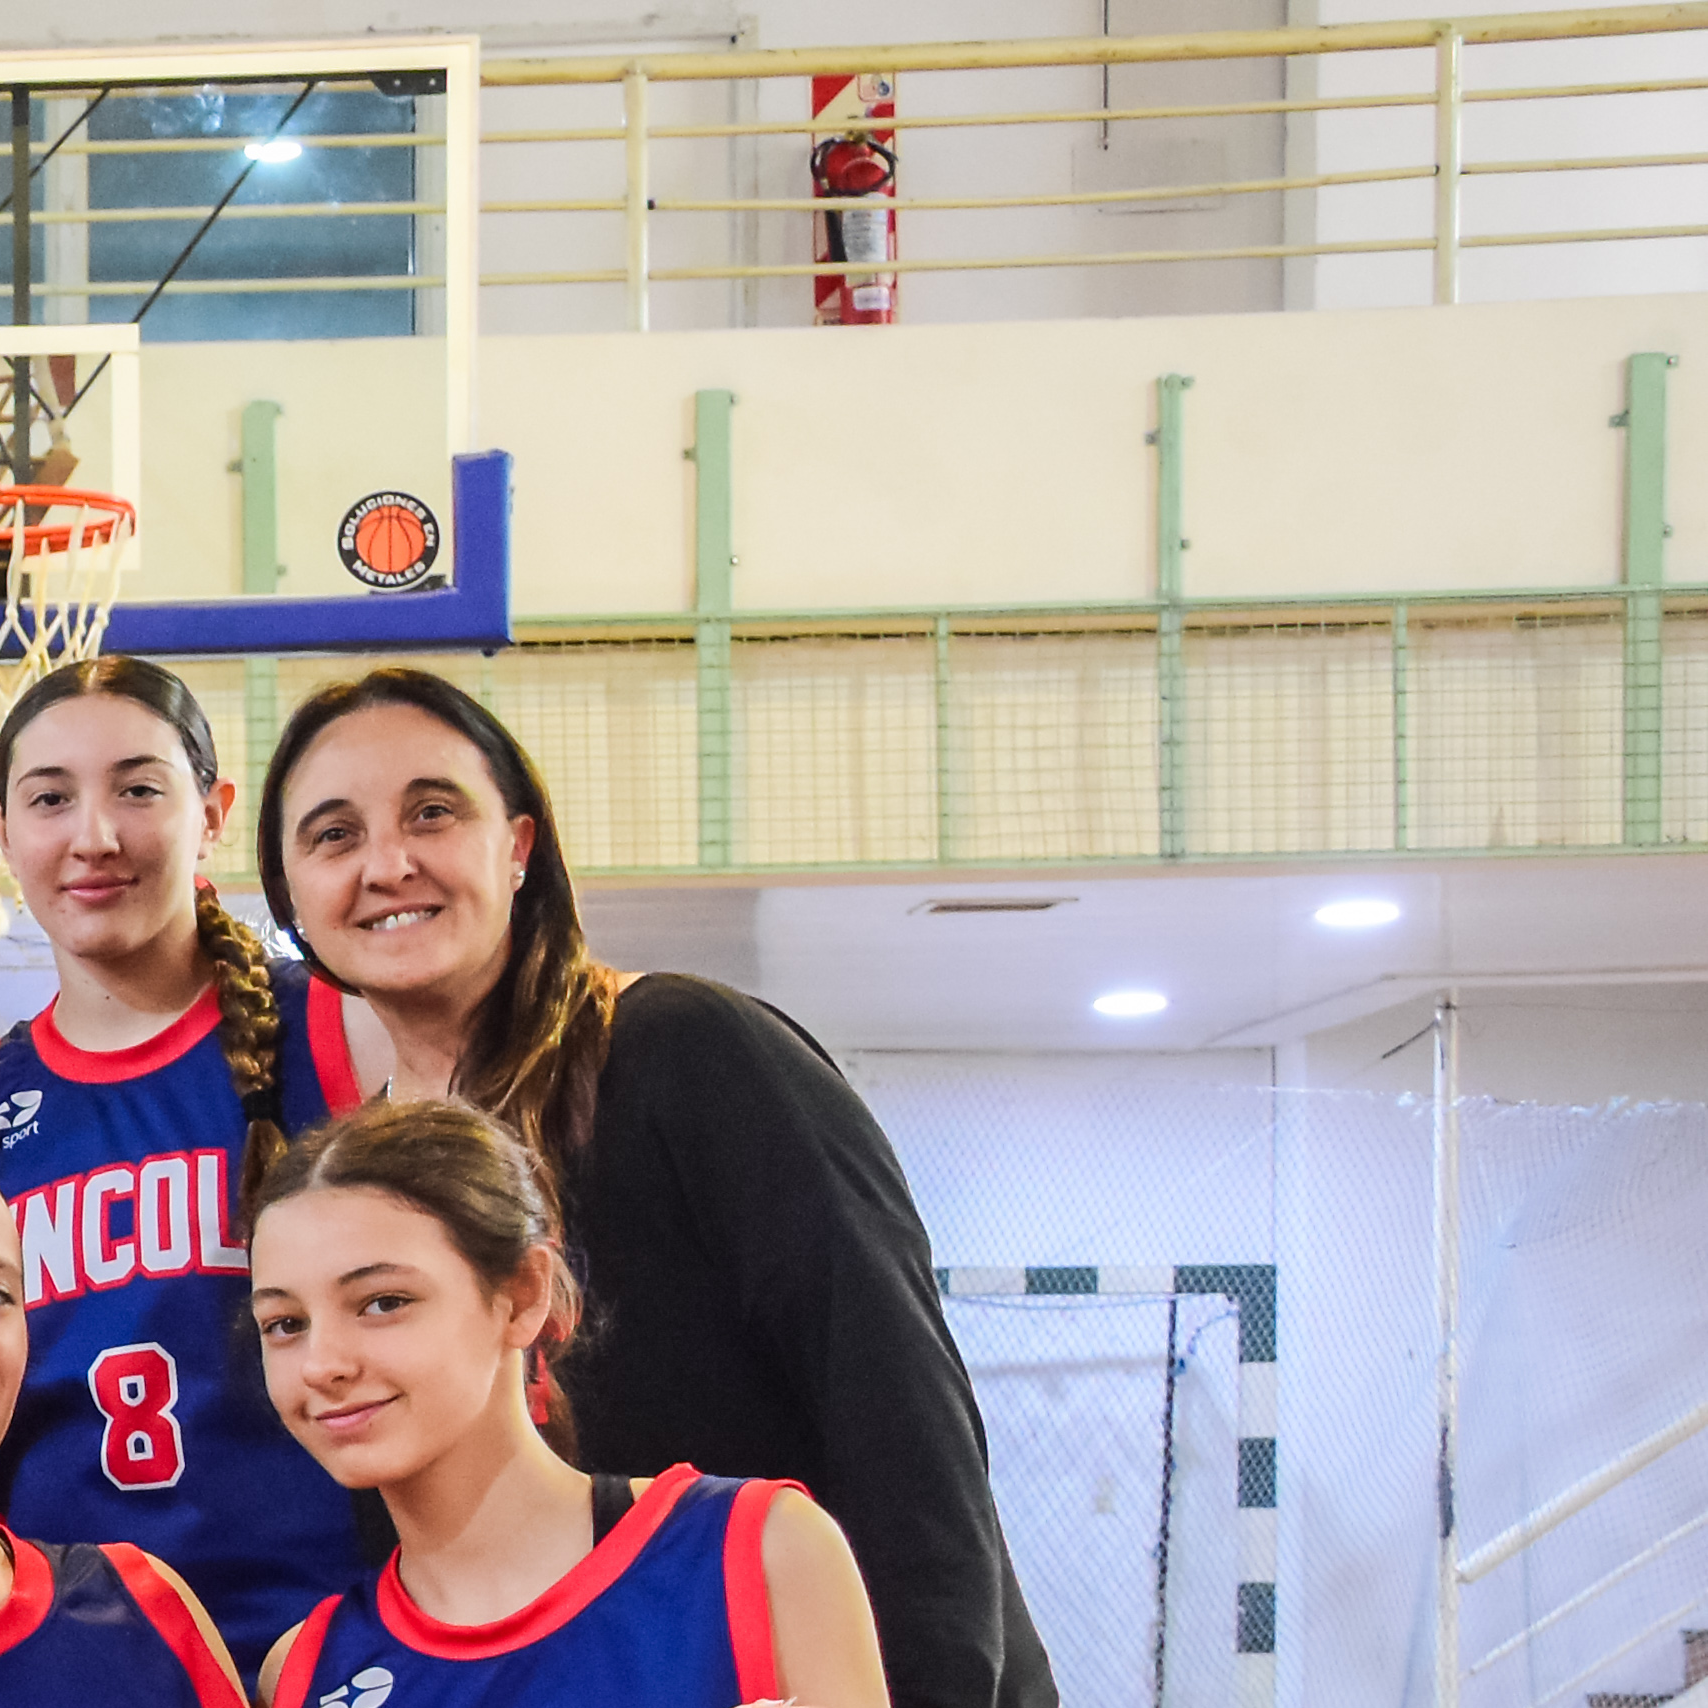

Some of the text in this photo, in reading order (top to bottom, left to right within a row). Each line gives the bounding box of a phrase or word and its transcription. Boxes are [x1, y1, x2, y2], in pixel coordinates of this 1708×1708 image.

[351, 559, 426, 586] METALES
[9, 1147, 254, 1313] NCOL
[87, 1341, 187, 1491] 8
